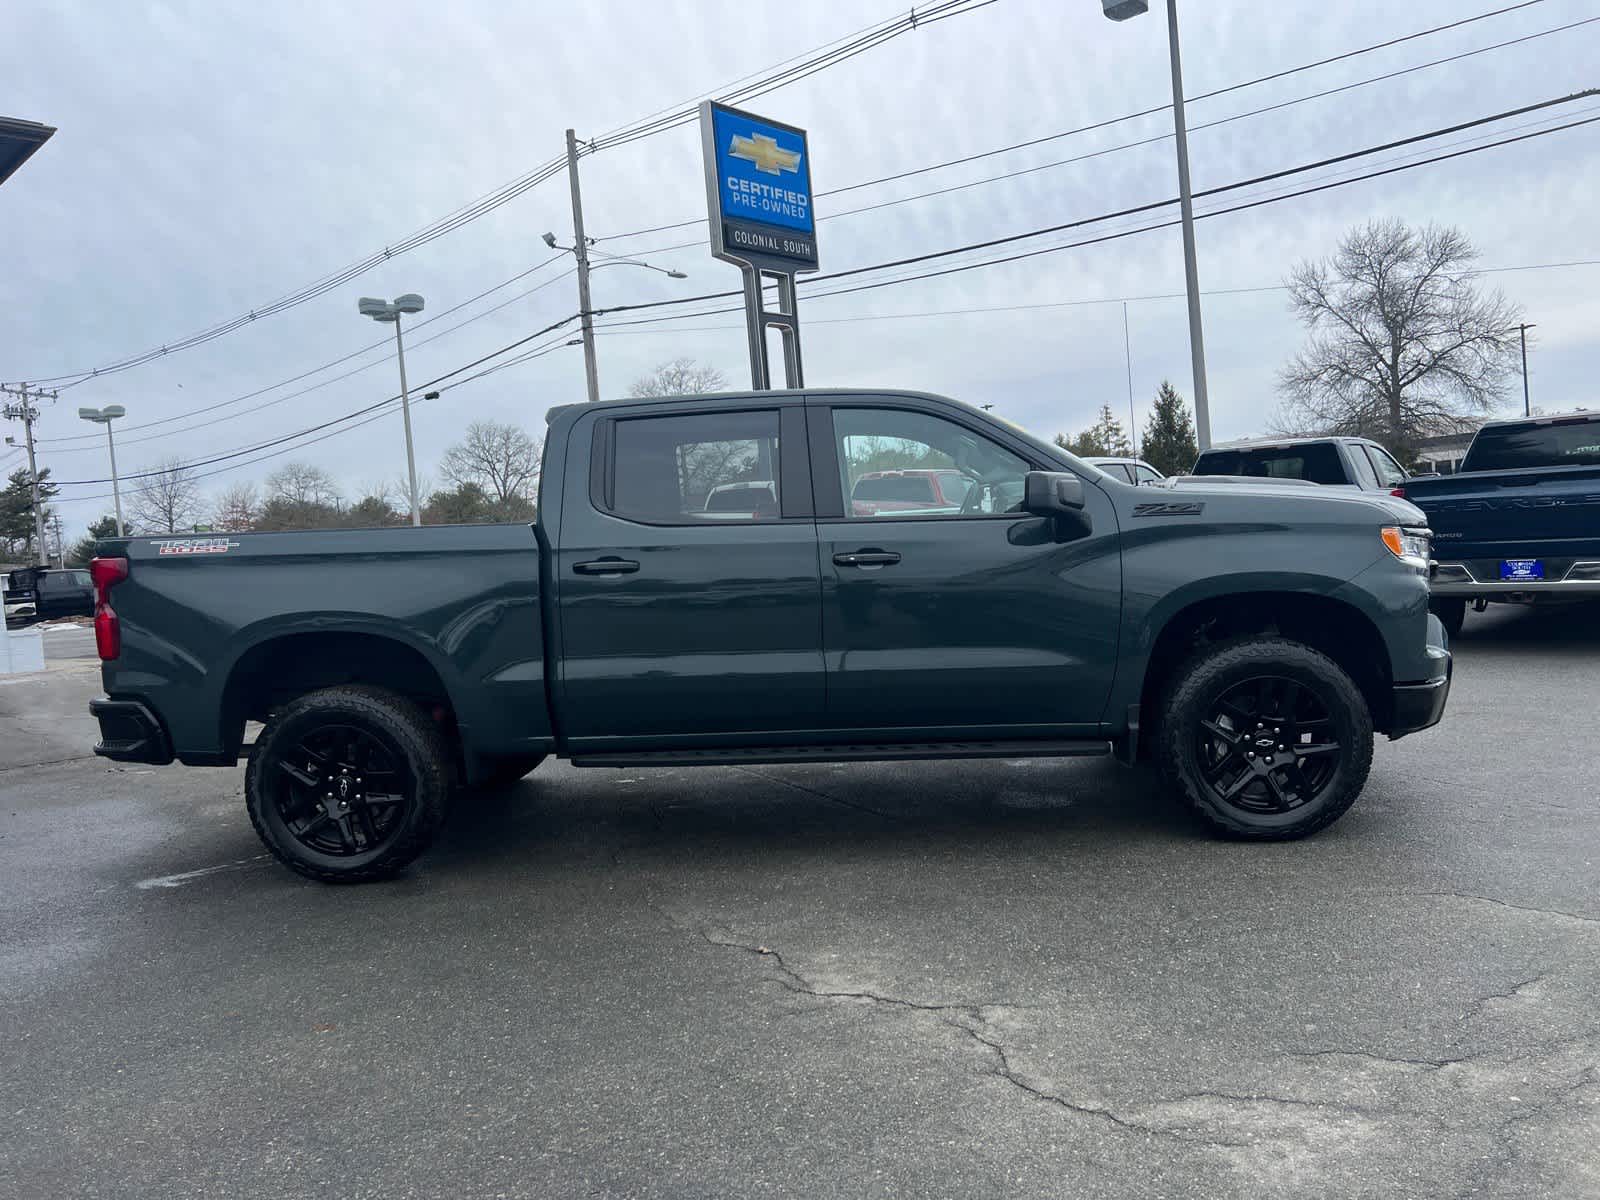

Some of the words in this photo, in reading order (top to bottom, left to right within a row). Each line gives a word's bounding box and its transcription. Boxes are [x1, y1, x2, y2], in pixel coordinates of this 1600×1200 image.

[728, 176, 807, 206] CERTIFIED
[733, 192, 805, 218] PRE-OWNED
[735, 230, 779, 250] COLONIAL
[784, 240, 810, 256] SOUTH
[160, 545, 228, 554] BOSS
